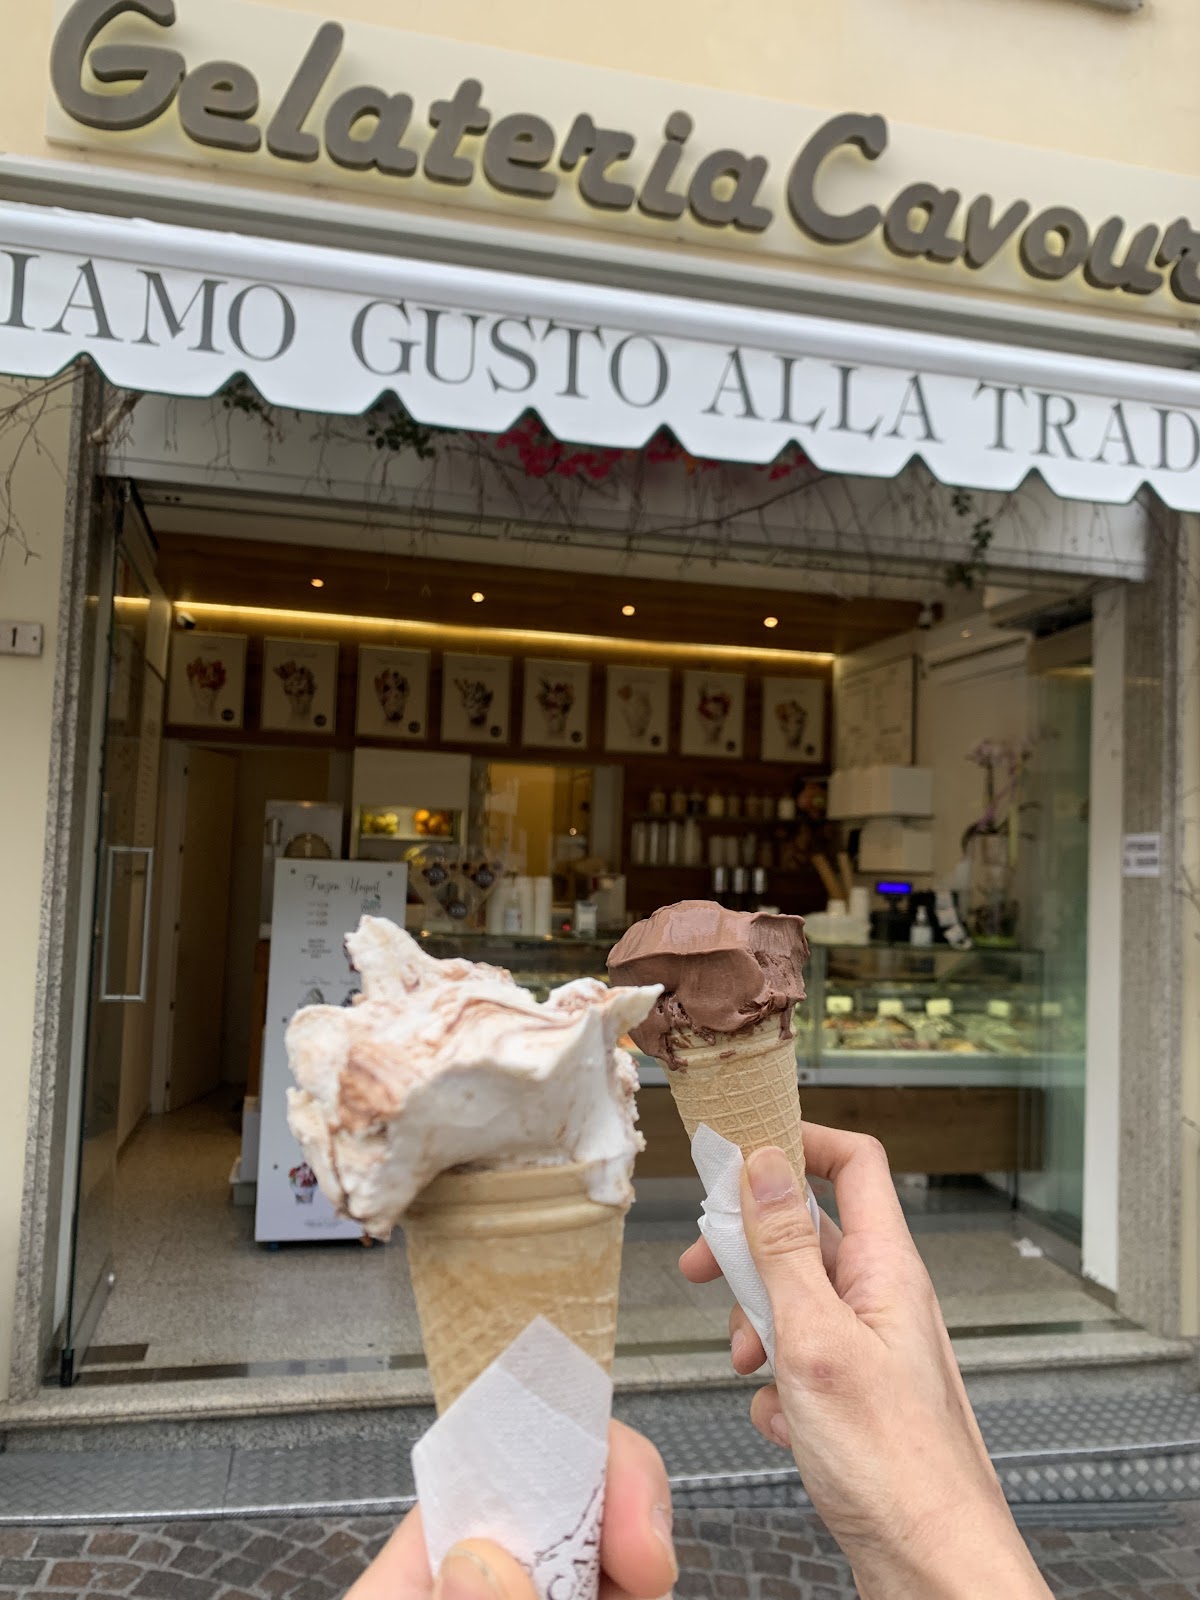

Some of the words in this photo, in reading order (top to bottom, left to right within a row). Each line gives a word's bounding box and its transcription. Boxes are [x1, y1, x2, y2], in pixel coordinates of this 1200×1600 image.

[50, 0, 774, 233] Gelateria
[786, 112, 1200, 304] Cavour
[0, 250, 297, 362] IAMO
[350, 299, 670, 408] GUSTO
[701, 346, 945, 444] ALLA
[973, 380, 1200, 474] TRAD
